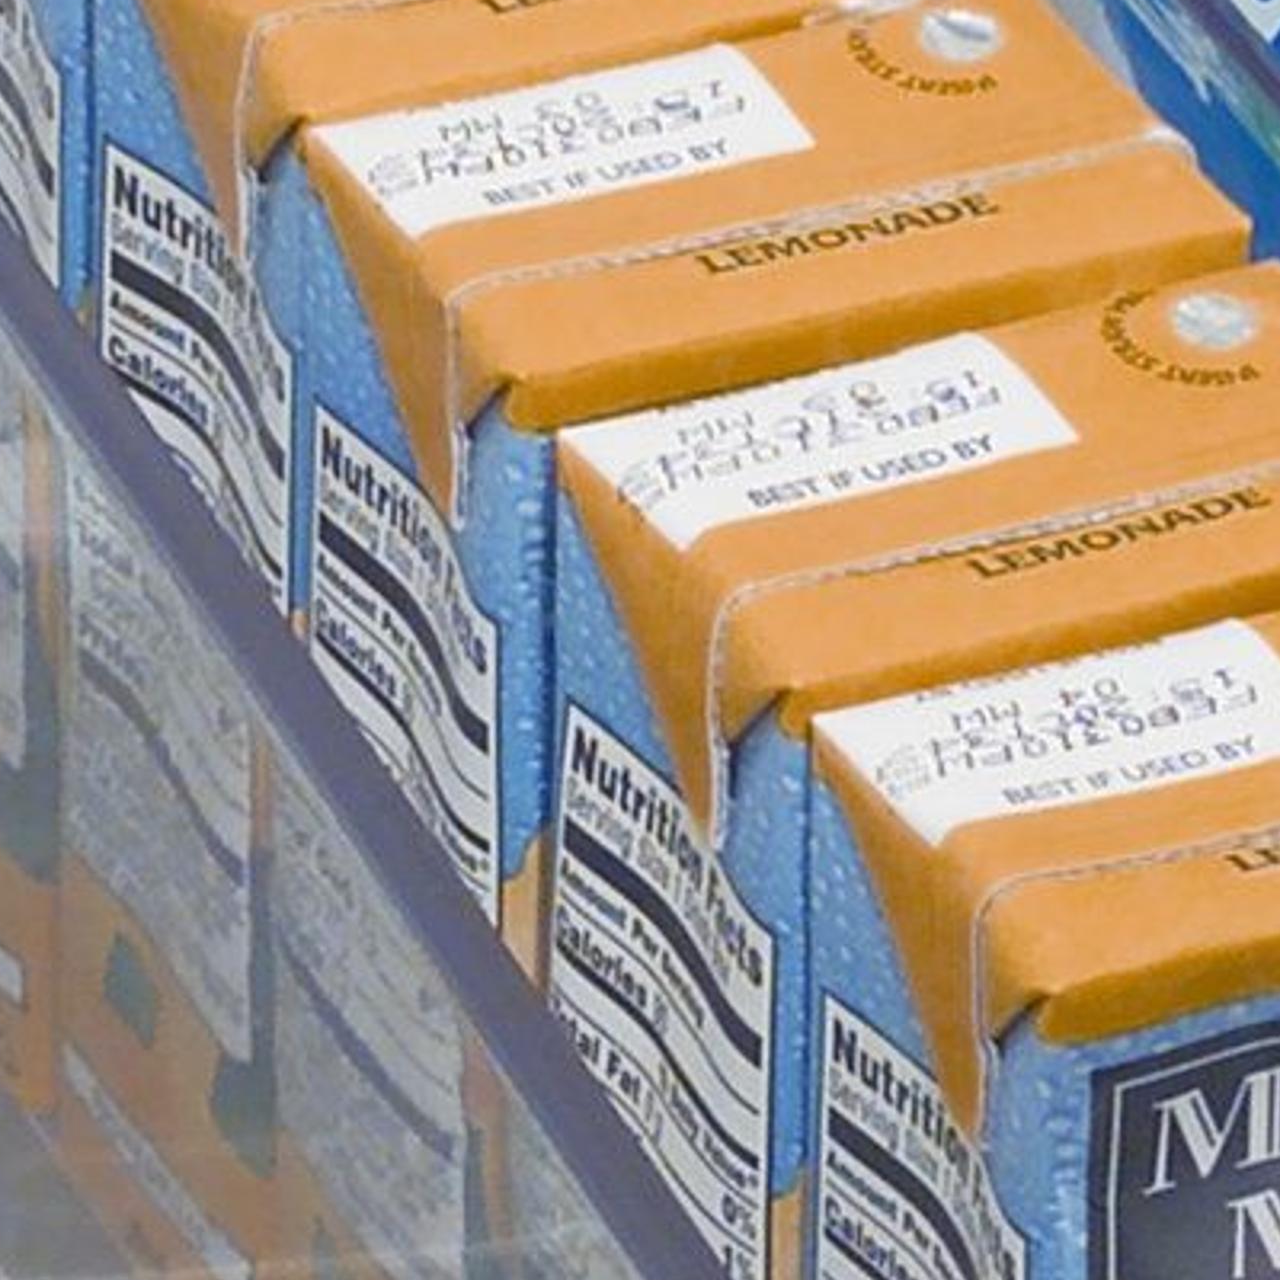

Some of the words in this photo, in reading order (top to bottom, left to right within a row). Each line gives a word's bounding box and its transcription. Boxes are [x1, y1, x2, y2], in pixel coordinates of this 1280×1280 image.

[484, 177, 557, 207] BEST
[598, 149, 681, 182] USED
[695, 193, 1000, 275] LEMONADE
[748, 475, 821, 509] BEST
[863, 445, 945, 482] USED
[965, 487, 1270, 581] LEMONADE
[571, 725, 703, 893] Nutrition
[1005, 773, 1077, 808] BEST
[1121, 745, 1205, 783] USED
[556, 904, 648, 1008] Calories
[831, 1017, 970, 1189] Nutrition
